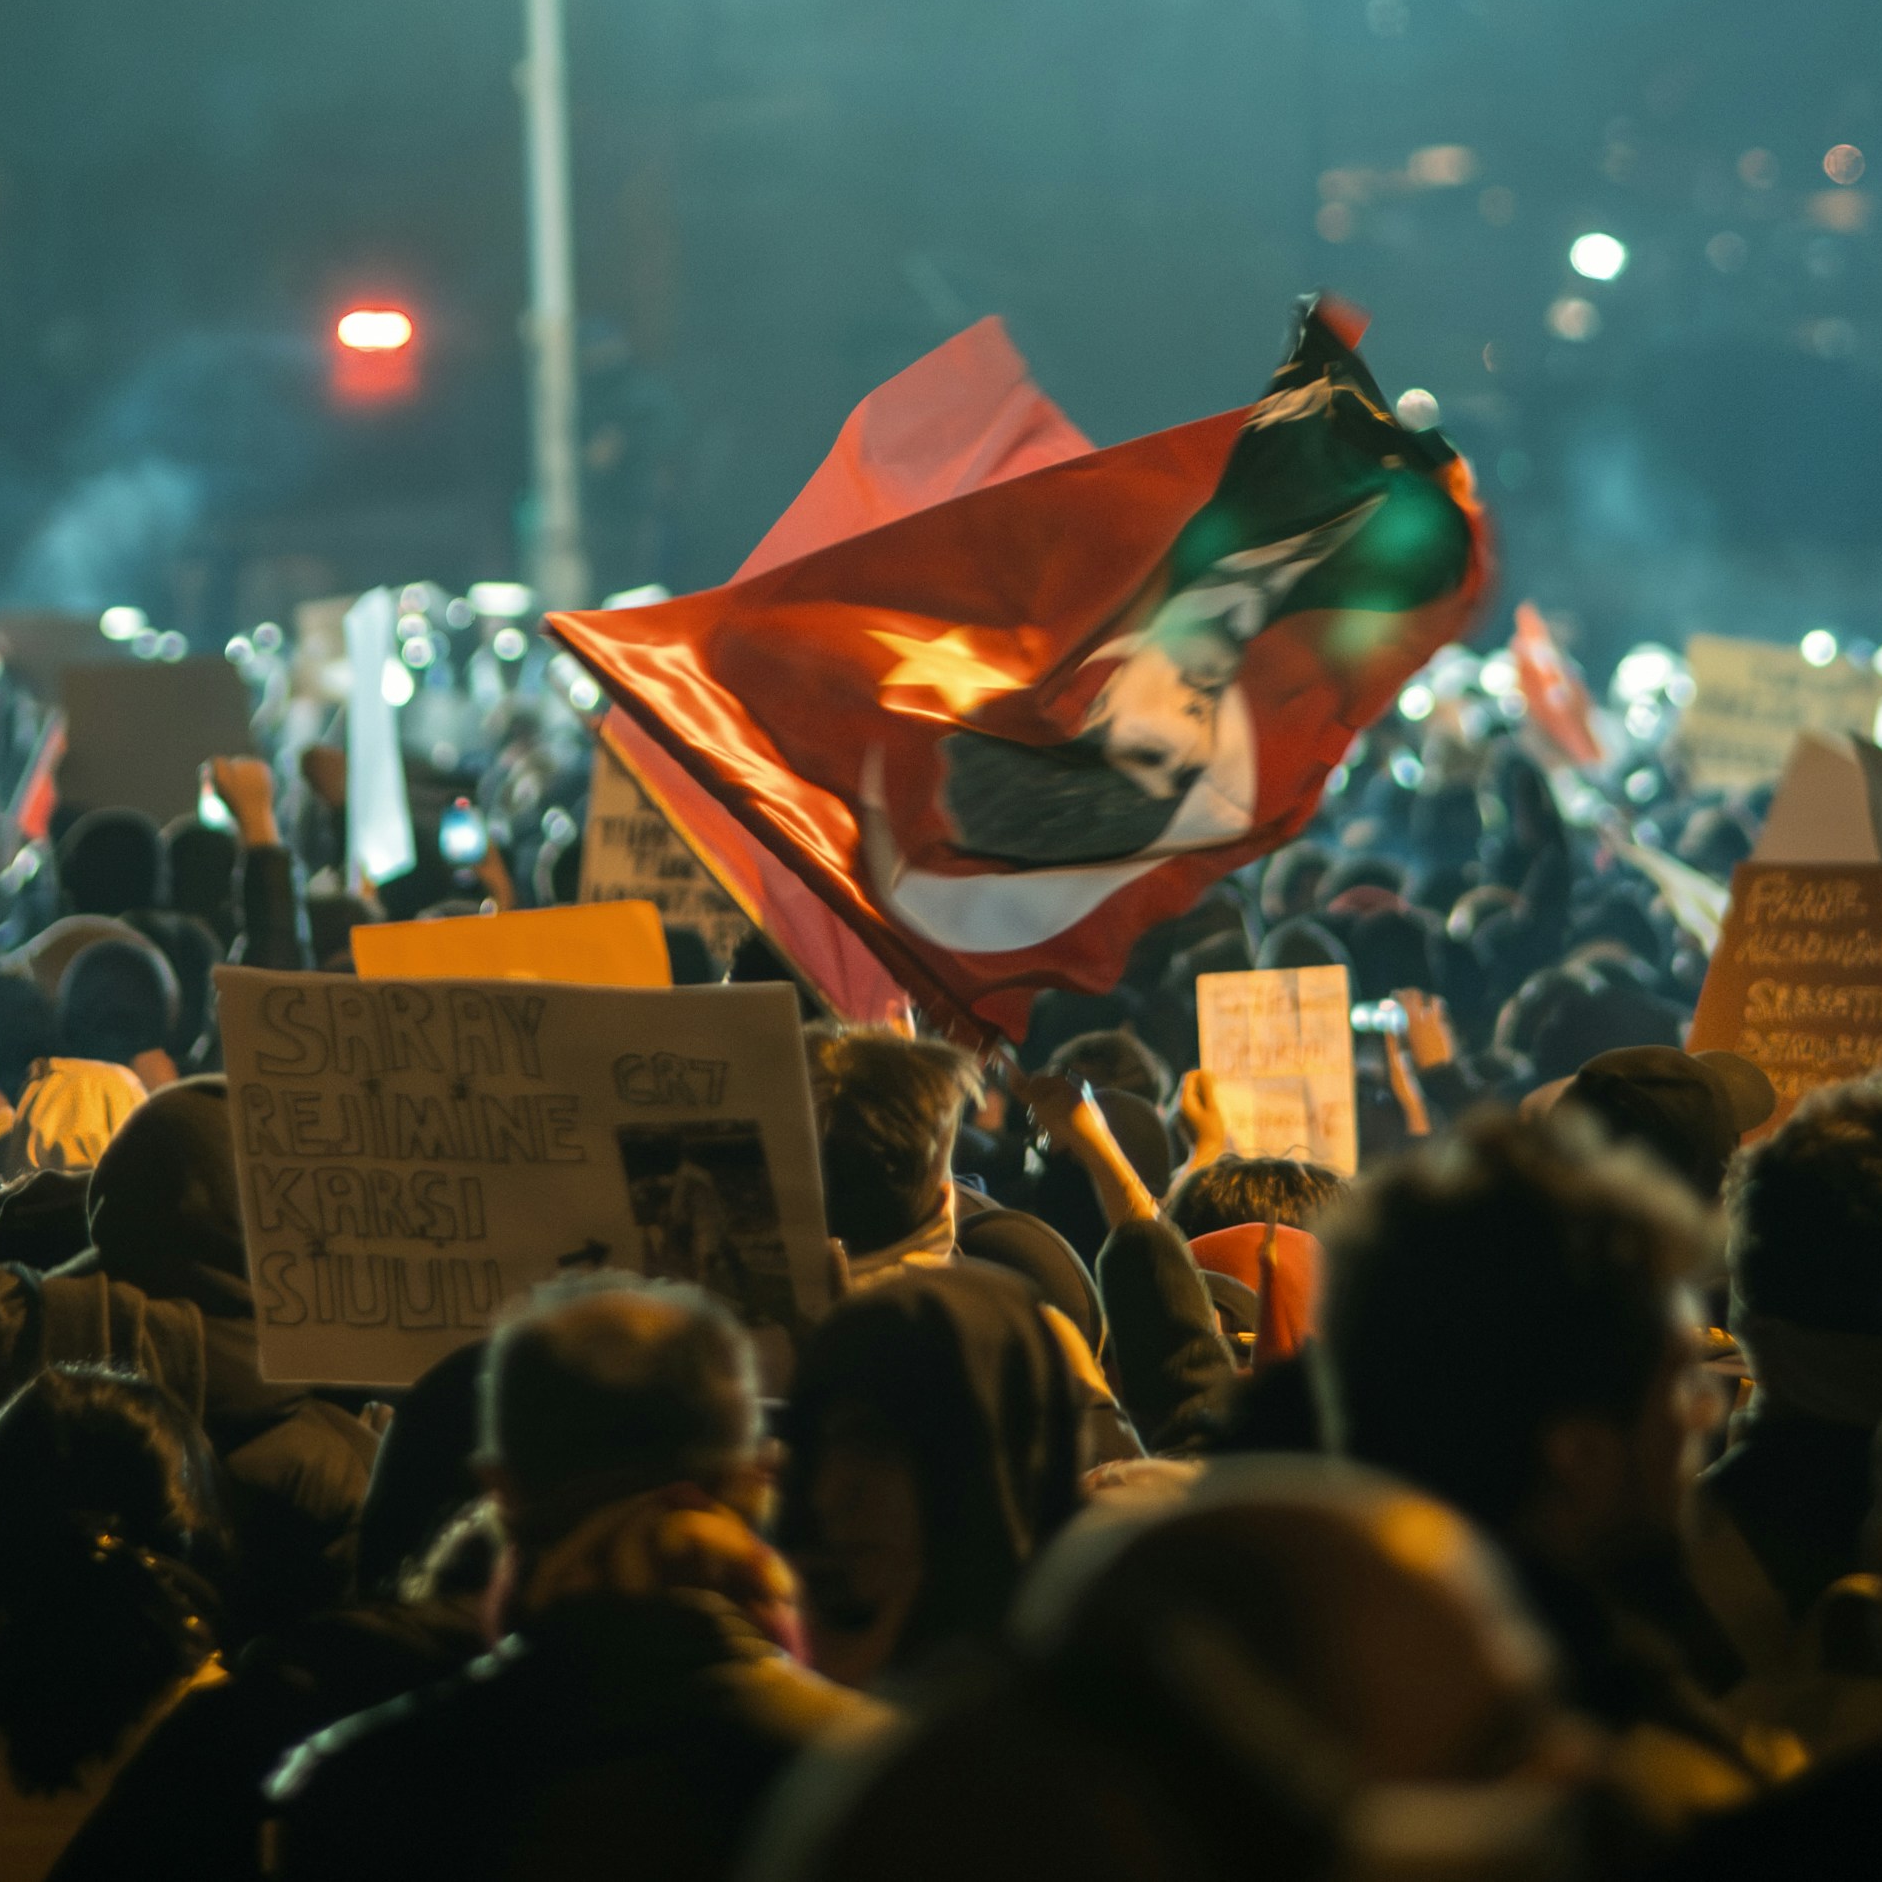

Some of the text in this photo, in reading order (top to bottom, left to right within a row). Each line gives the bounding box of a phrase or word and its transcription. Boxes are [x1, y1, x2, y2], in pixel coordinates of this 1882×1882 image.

[256, 984, 547, 1079] SARAY
[239, 1078, 587, 1164] REJİMİNE
[611, 1051, 730, 1107] CR7
[248, 1162, 487, 1248] KARŞI
